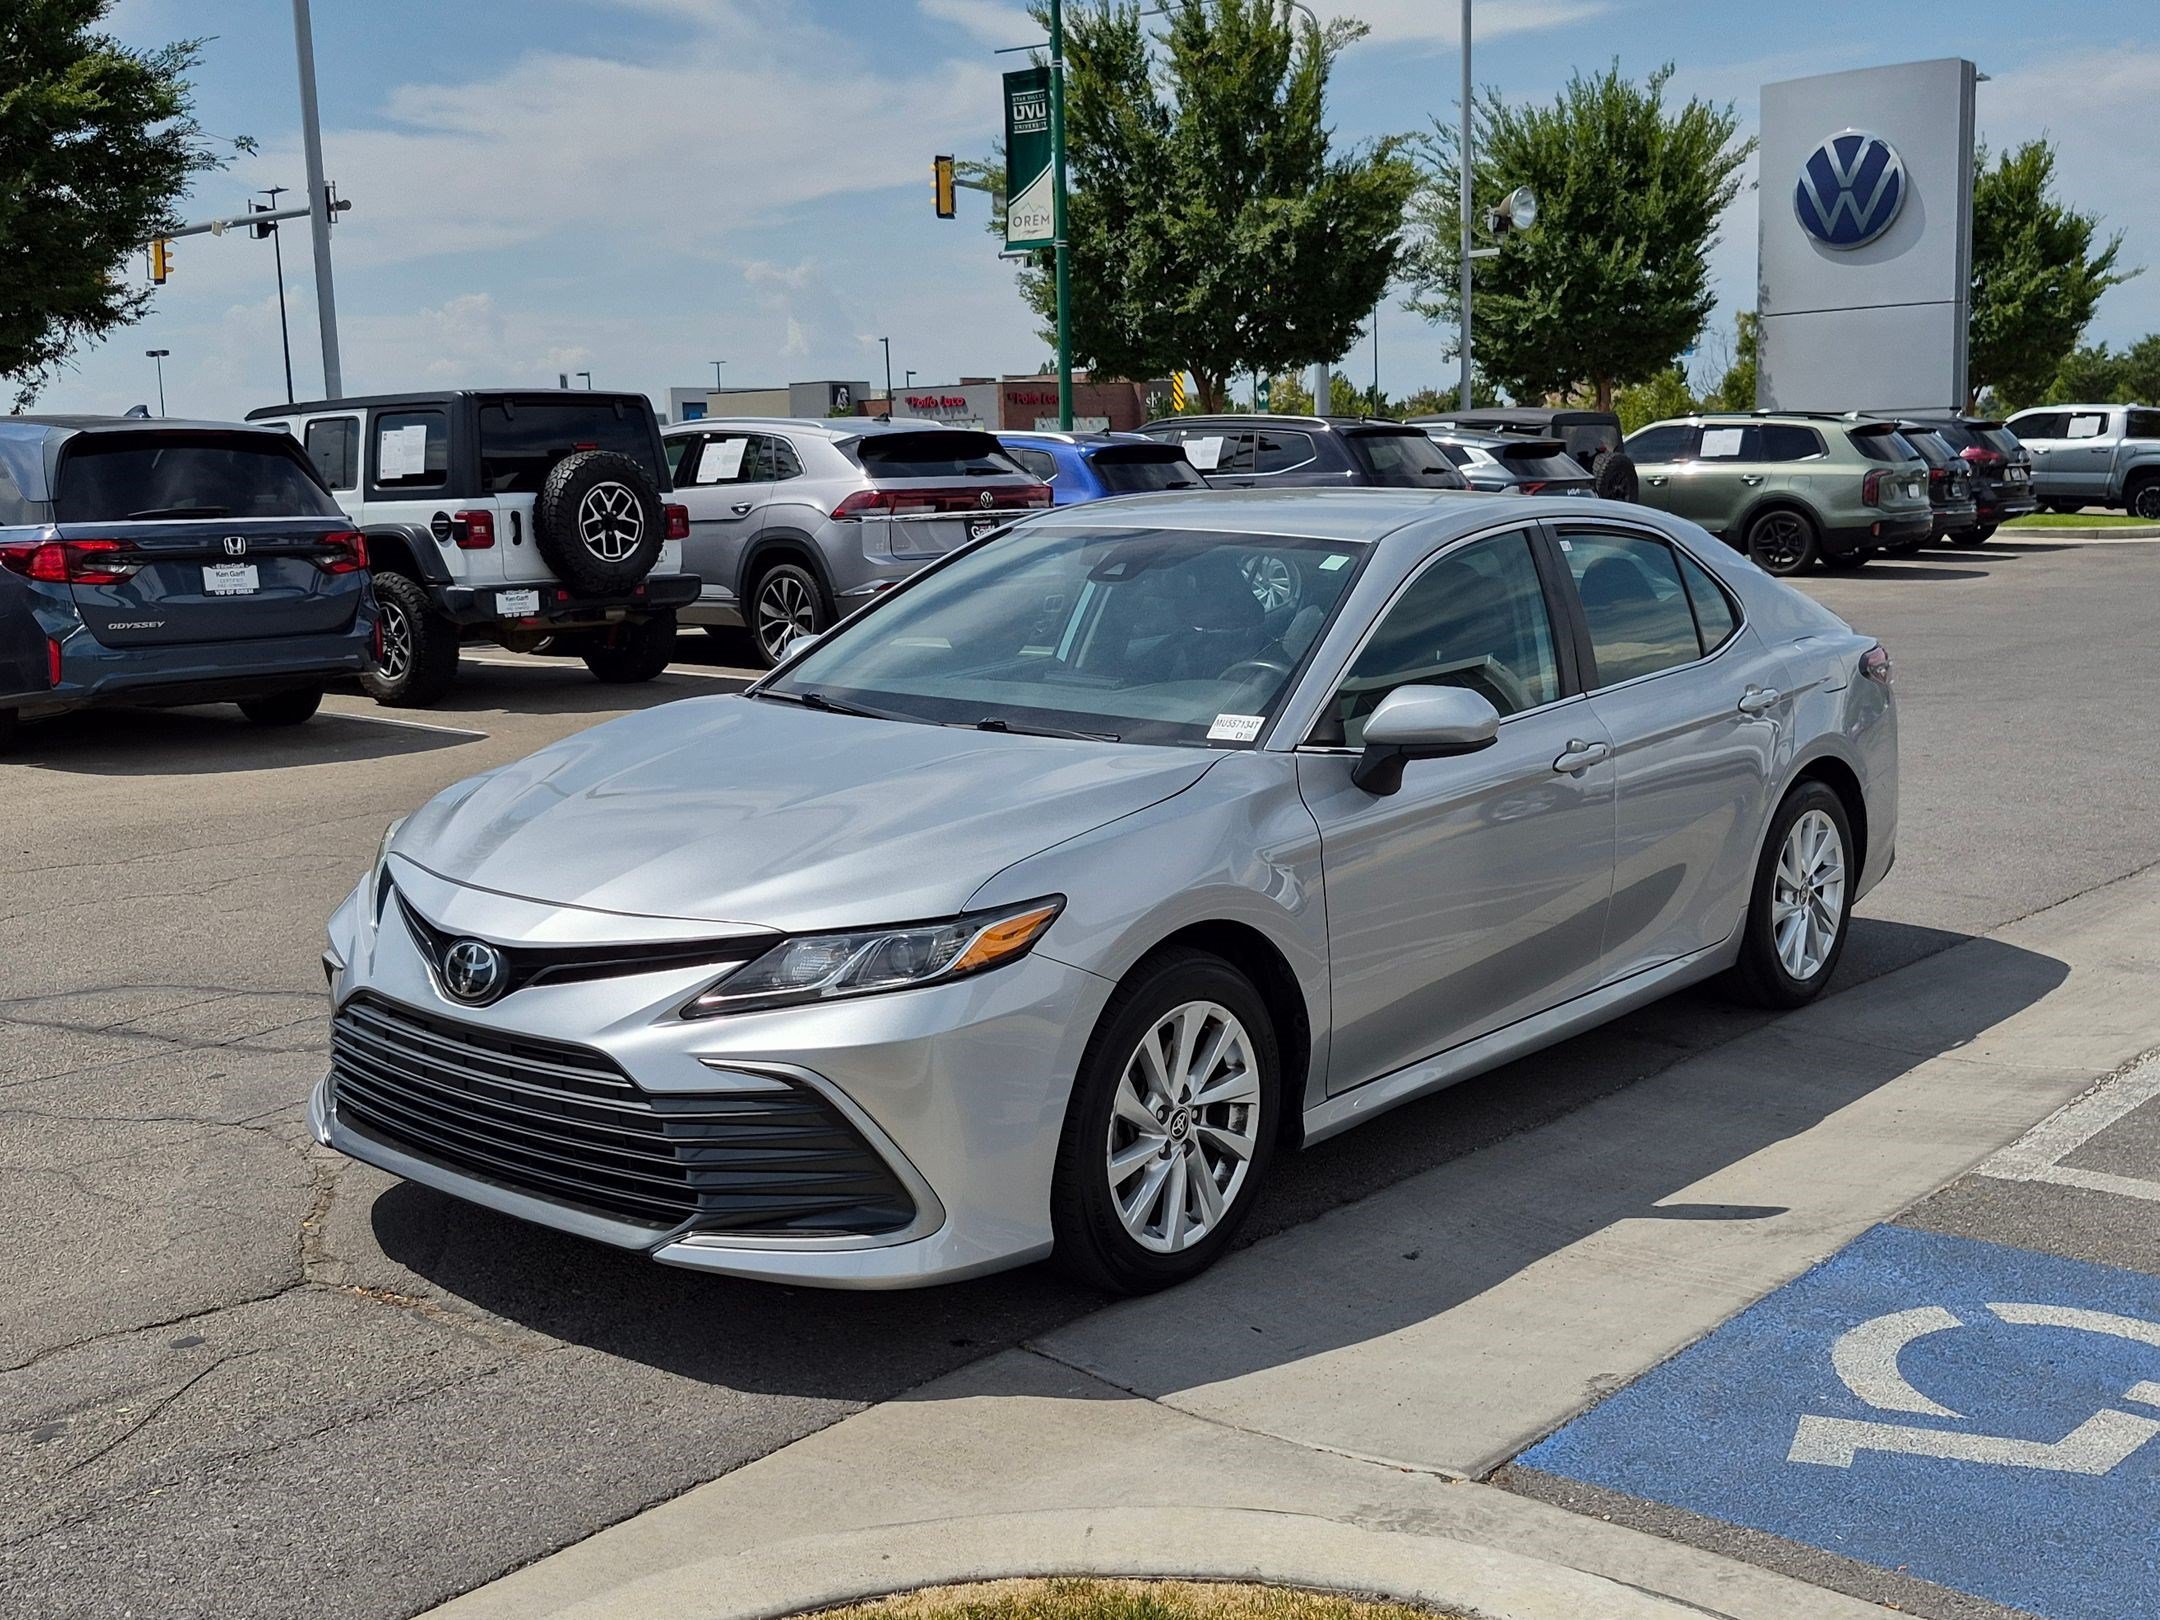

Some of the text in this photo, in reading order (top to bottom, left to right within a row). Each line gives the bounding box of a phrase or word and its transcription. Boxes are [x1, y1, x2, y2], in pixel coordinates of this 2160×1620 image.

[1013, 102, 1046, 120] UVU
[1013, 214, 1050, 227] OREM
[108, 621, 165, 630] ODYSSEY
